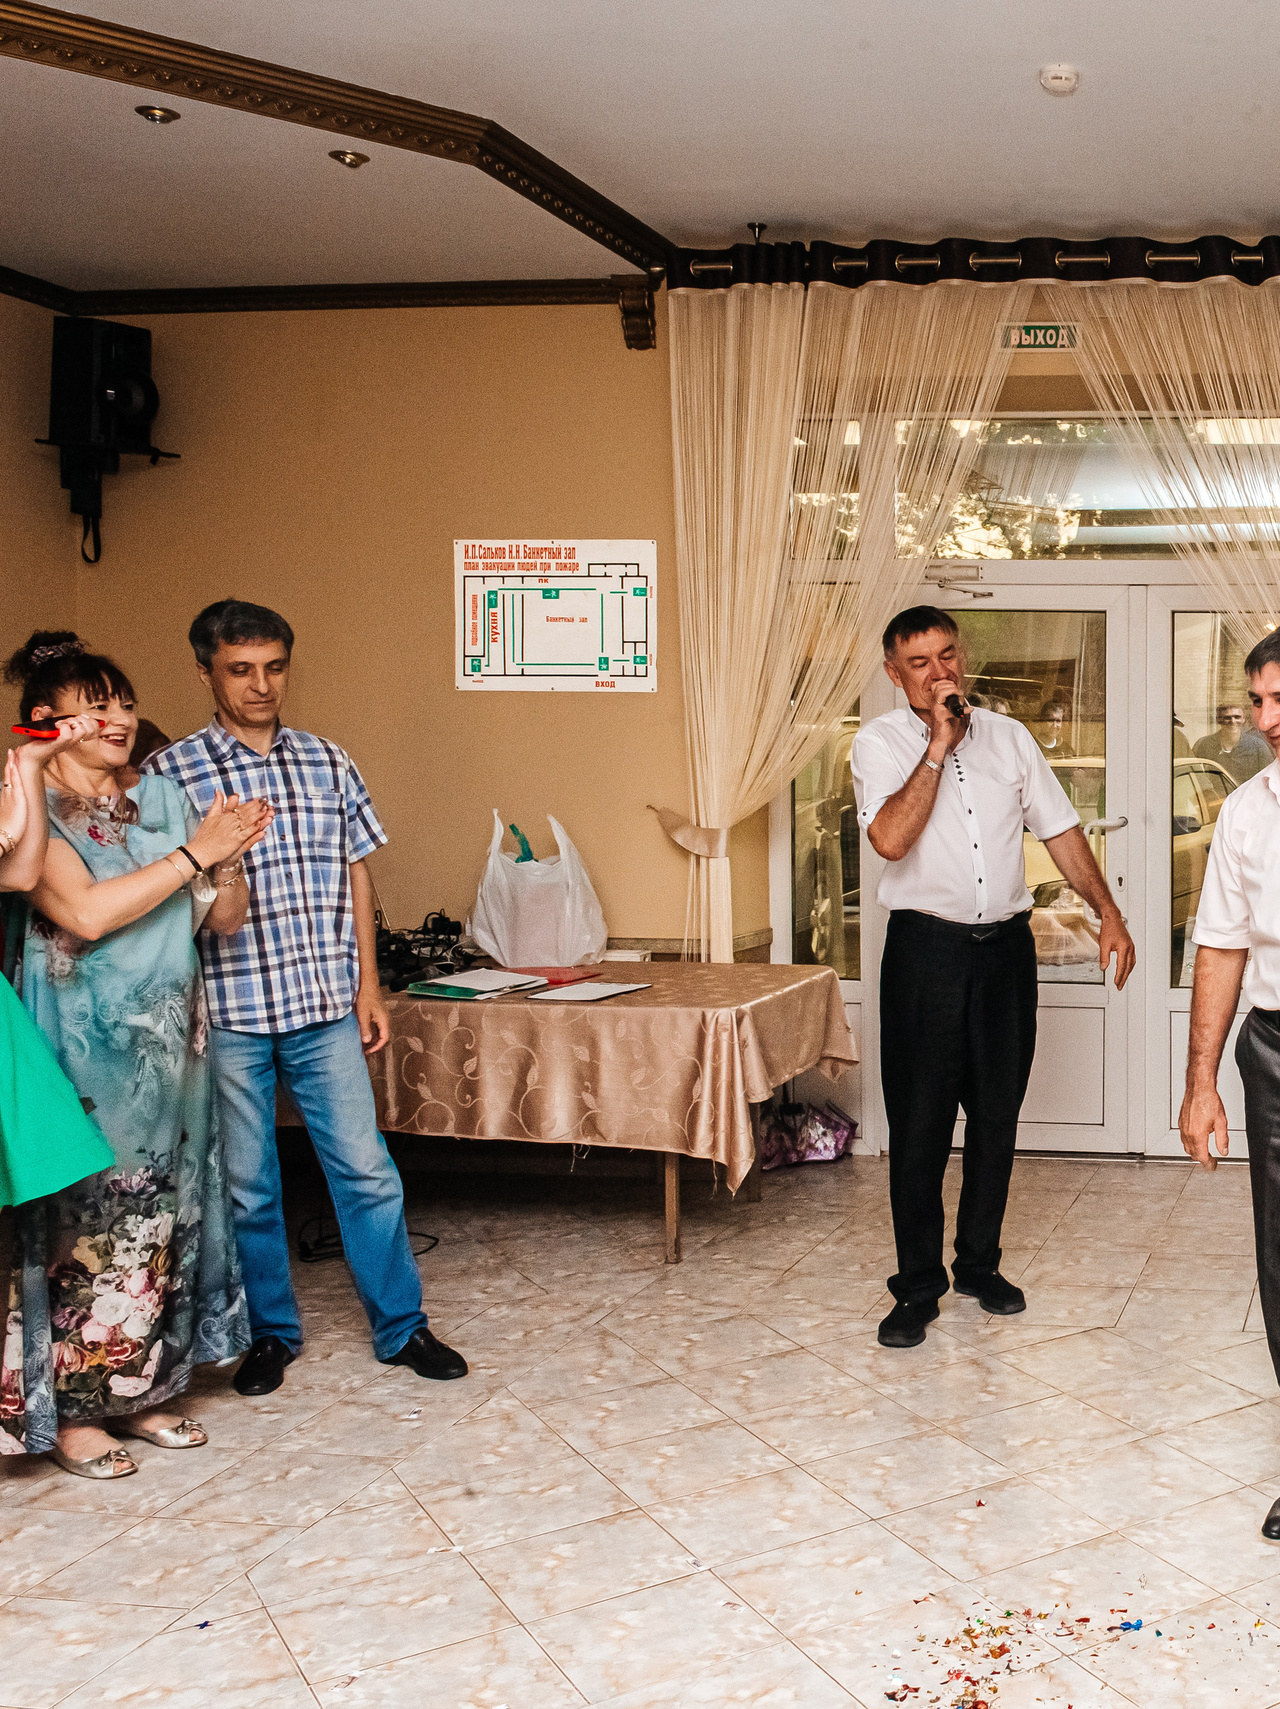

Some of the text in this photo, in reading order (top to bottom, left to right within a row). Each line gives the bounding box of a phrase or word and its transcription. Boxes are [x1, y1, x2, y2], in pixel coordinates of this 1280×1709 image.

[1010, 329, 1069, 347] ВЫХОД
[523, 544, 562, 560] Банкетный
[563, 547, 576, 560] зал
[464, 561, 480, 571] план
[517, 560, 538, 572] людей
[539, 562, 551, 574] при
[555, 562, 580, 574] пожаре
